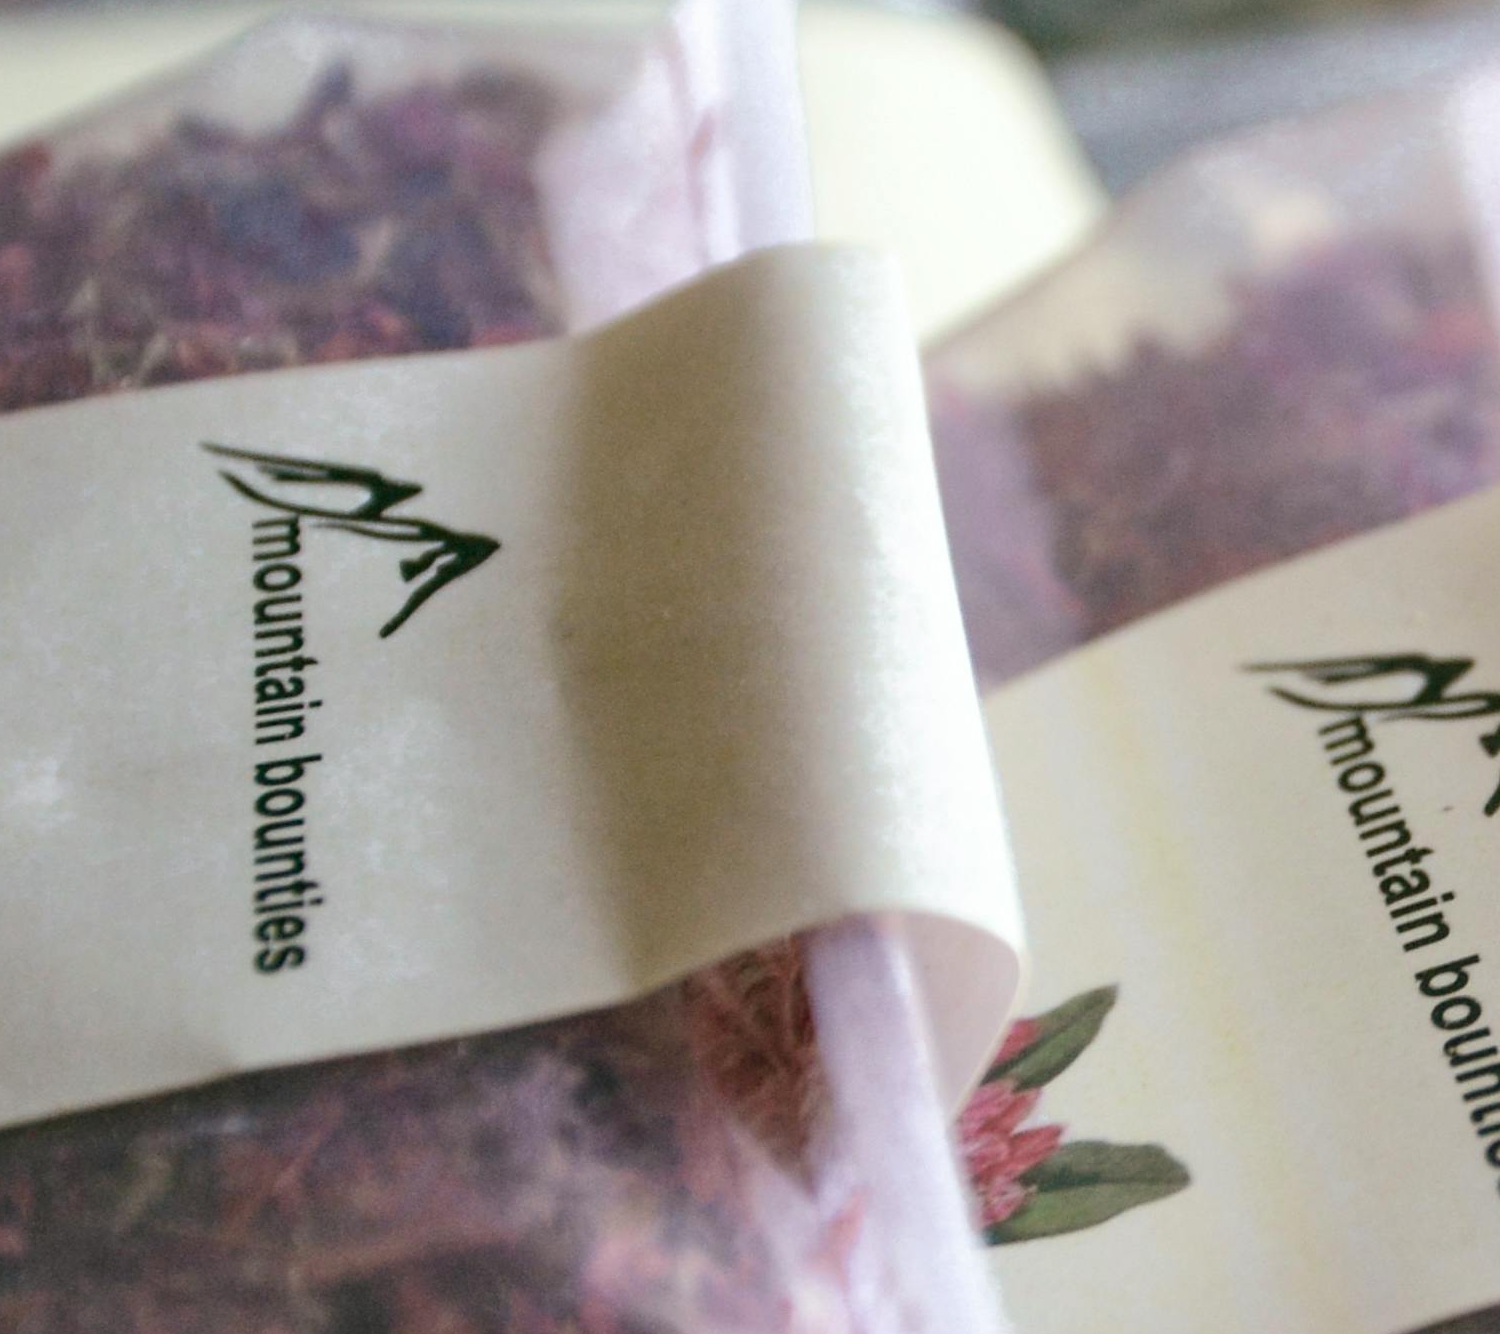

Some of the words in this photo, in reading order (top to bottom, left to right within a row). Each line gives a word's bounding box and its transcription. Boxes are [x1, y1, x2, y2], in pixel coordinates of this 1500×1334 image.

[252, 515, 322, 745] mountain
[254, 754, 324, 974] bounties
[1318, 714, 1455, 953] mountain
